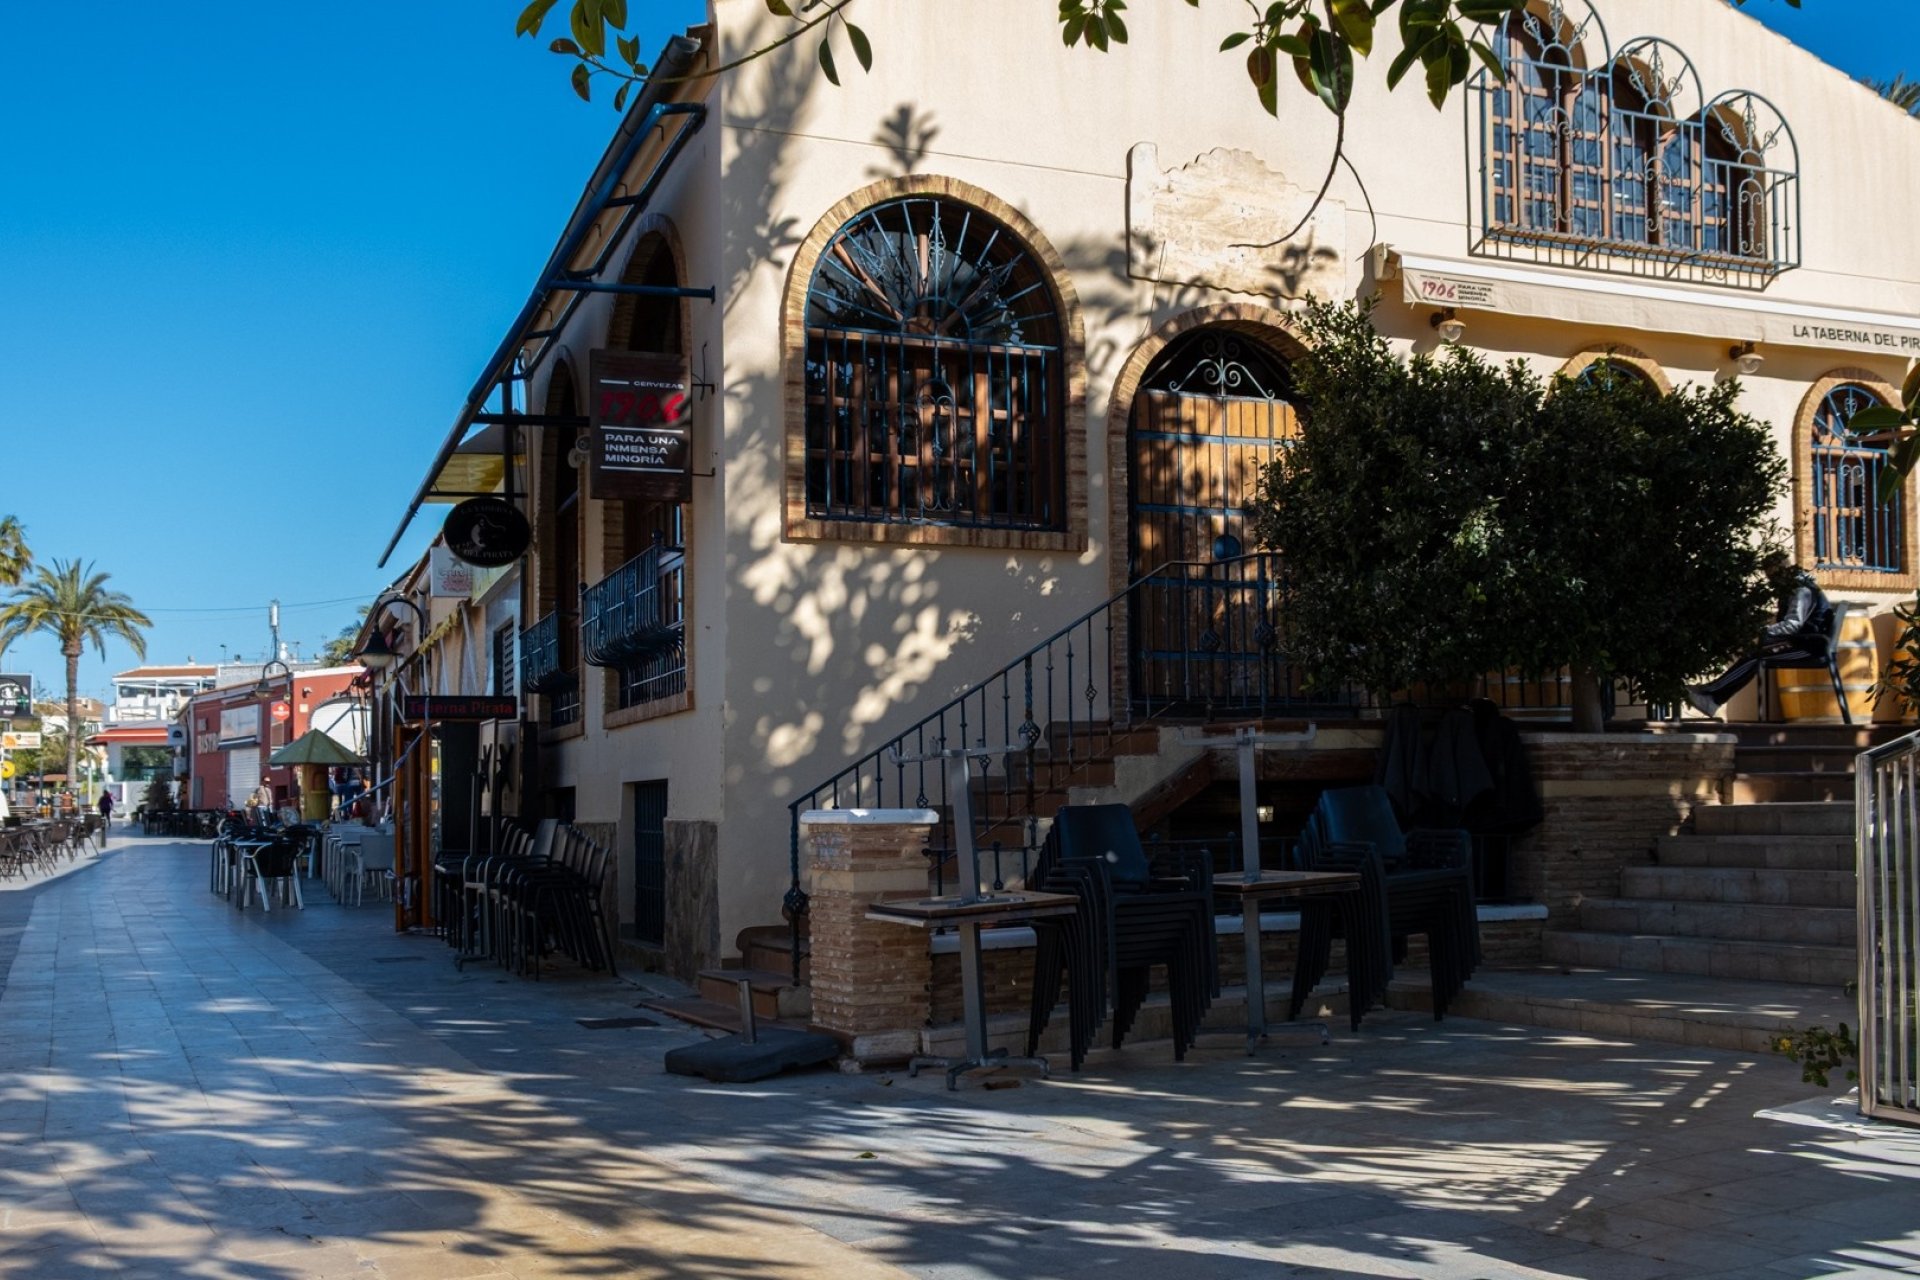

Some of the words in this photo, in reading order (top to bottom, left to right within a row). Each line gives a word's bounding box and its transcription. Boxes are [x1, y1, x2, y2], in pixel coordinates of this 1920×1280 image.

[1422, 281, 1456, 298] 1906
[1793, 325, 1809, 338] LA
[1811, 326, 1871, 344] TABERNA
[1874, 333, 1898, 347] DEL
[633, 381, 685, 389] CERVEZAS
[600, 390, 684, 424] 1906
[604, 433, 644, 443] PARA
[648, 435, 679, 445] UNA
[604, 443, 669, 455] INMENSA
[604, 453, 665, 465] MINORÍA
